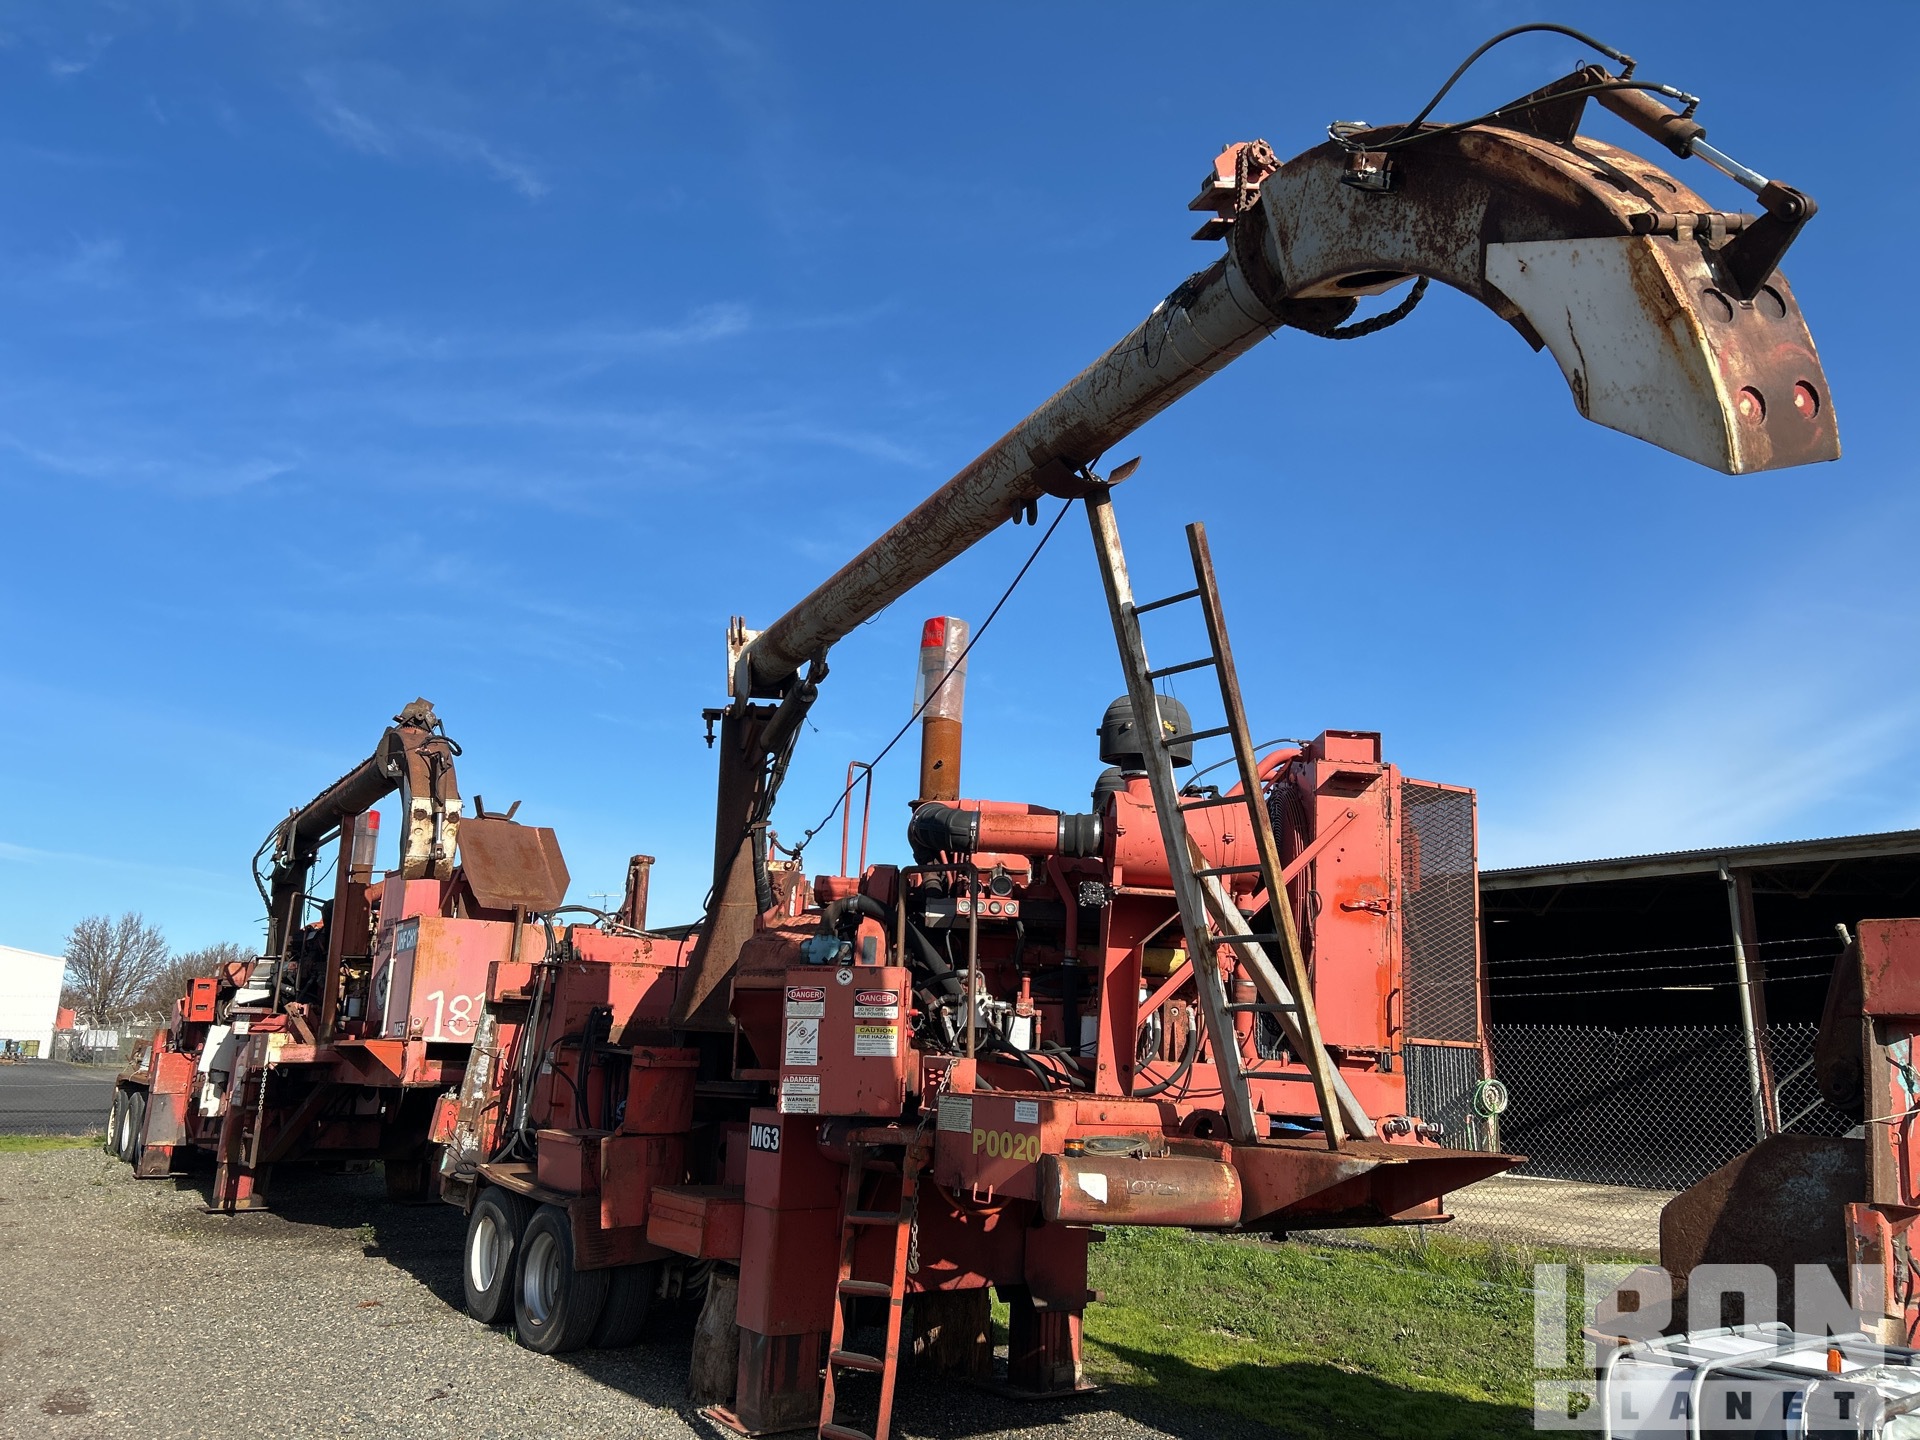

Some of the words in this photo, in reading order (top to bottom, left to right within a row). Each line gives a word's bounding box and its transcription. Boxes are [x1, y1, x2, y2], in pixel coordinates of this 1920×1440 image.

[859, 994, 895, 1002] DANGER!
[443, 1018, 463, 1028] LOT
[751, 1125, 779, 1150] M63
[972, 1128, 1040, 1163] P0020
